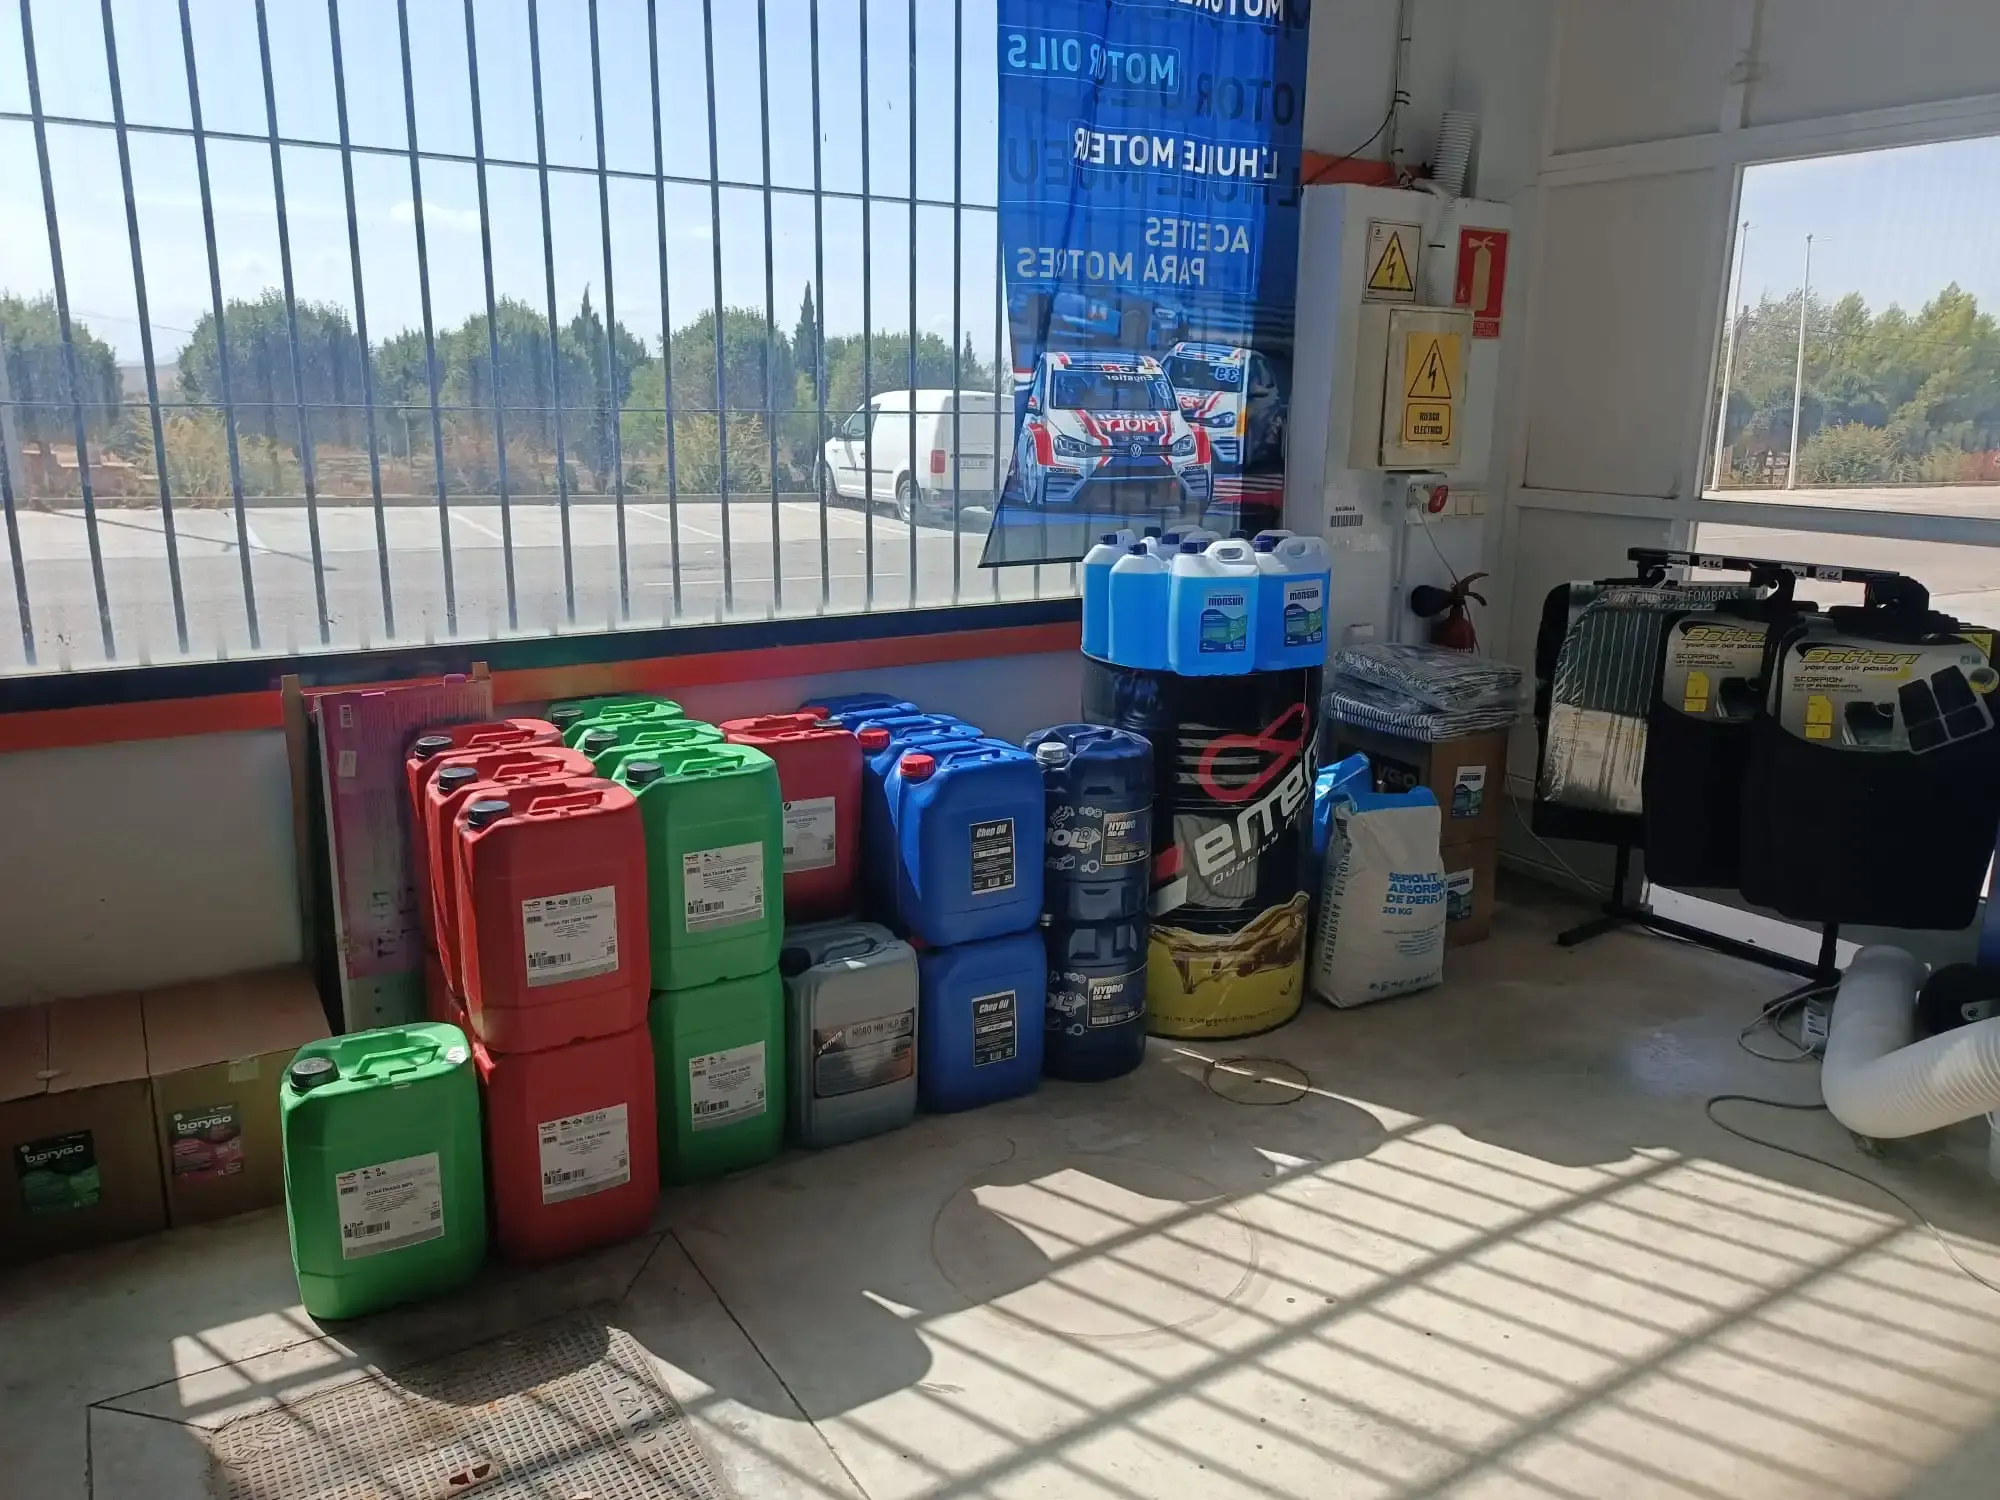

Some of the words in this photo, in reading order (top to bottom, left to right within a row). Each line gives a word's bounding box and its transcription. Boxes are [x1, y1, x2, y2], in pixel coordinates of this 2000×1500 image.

[1208, 596, 1244, 606] monsun
[1801, 648, 1921, 664] Bottari
[1107, 820, 1136, 831] HYDRO
[1386, 894, 1404, 904] DE
[1382, 906, 1396, 914] 20
[1398, 907, 1412, 915] KG
[1092, 983, 1124, 995] HYDRO
